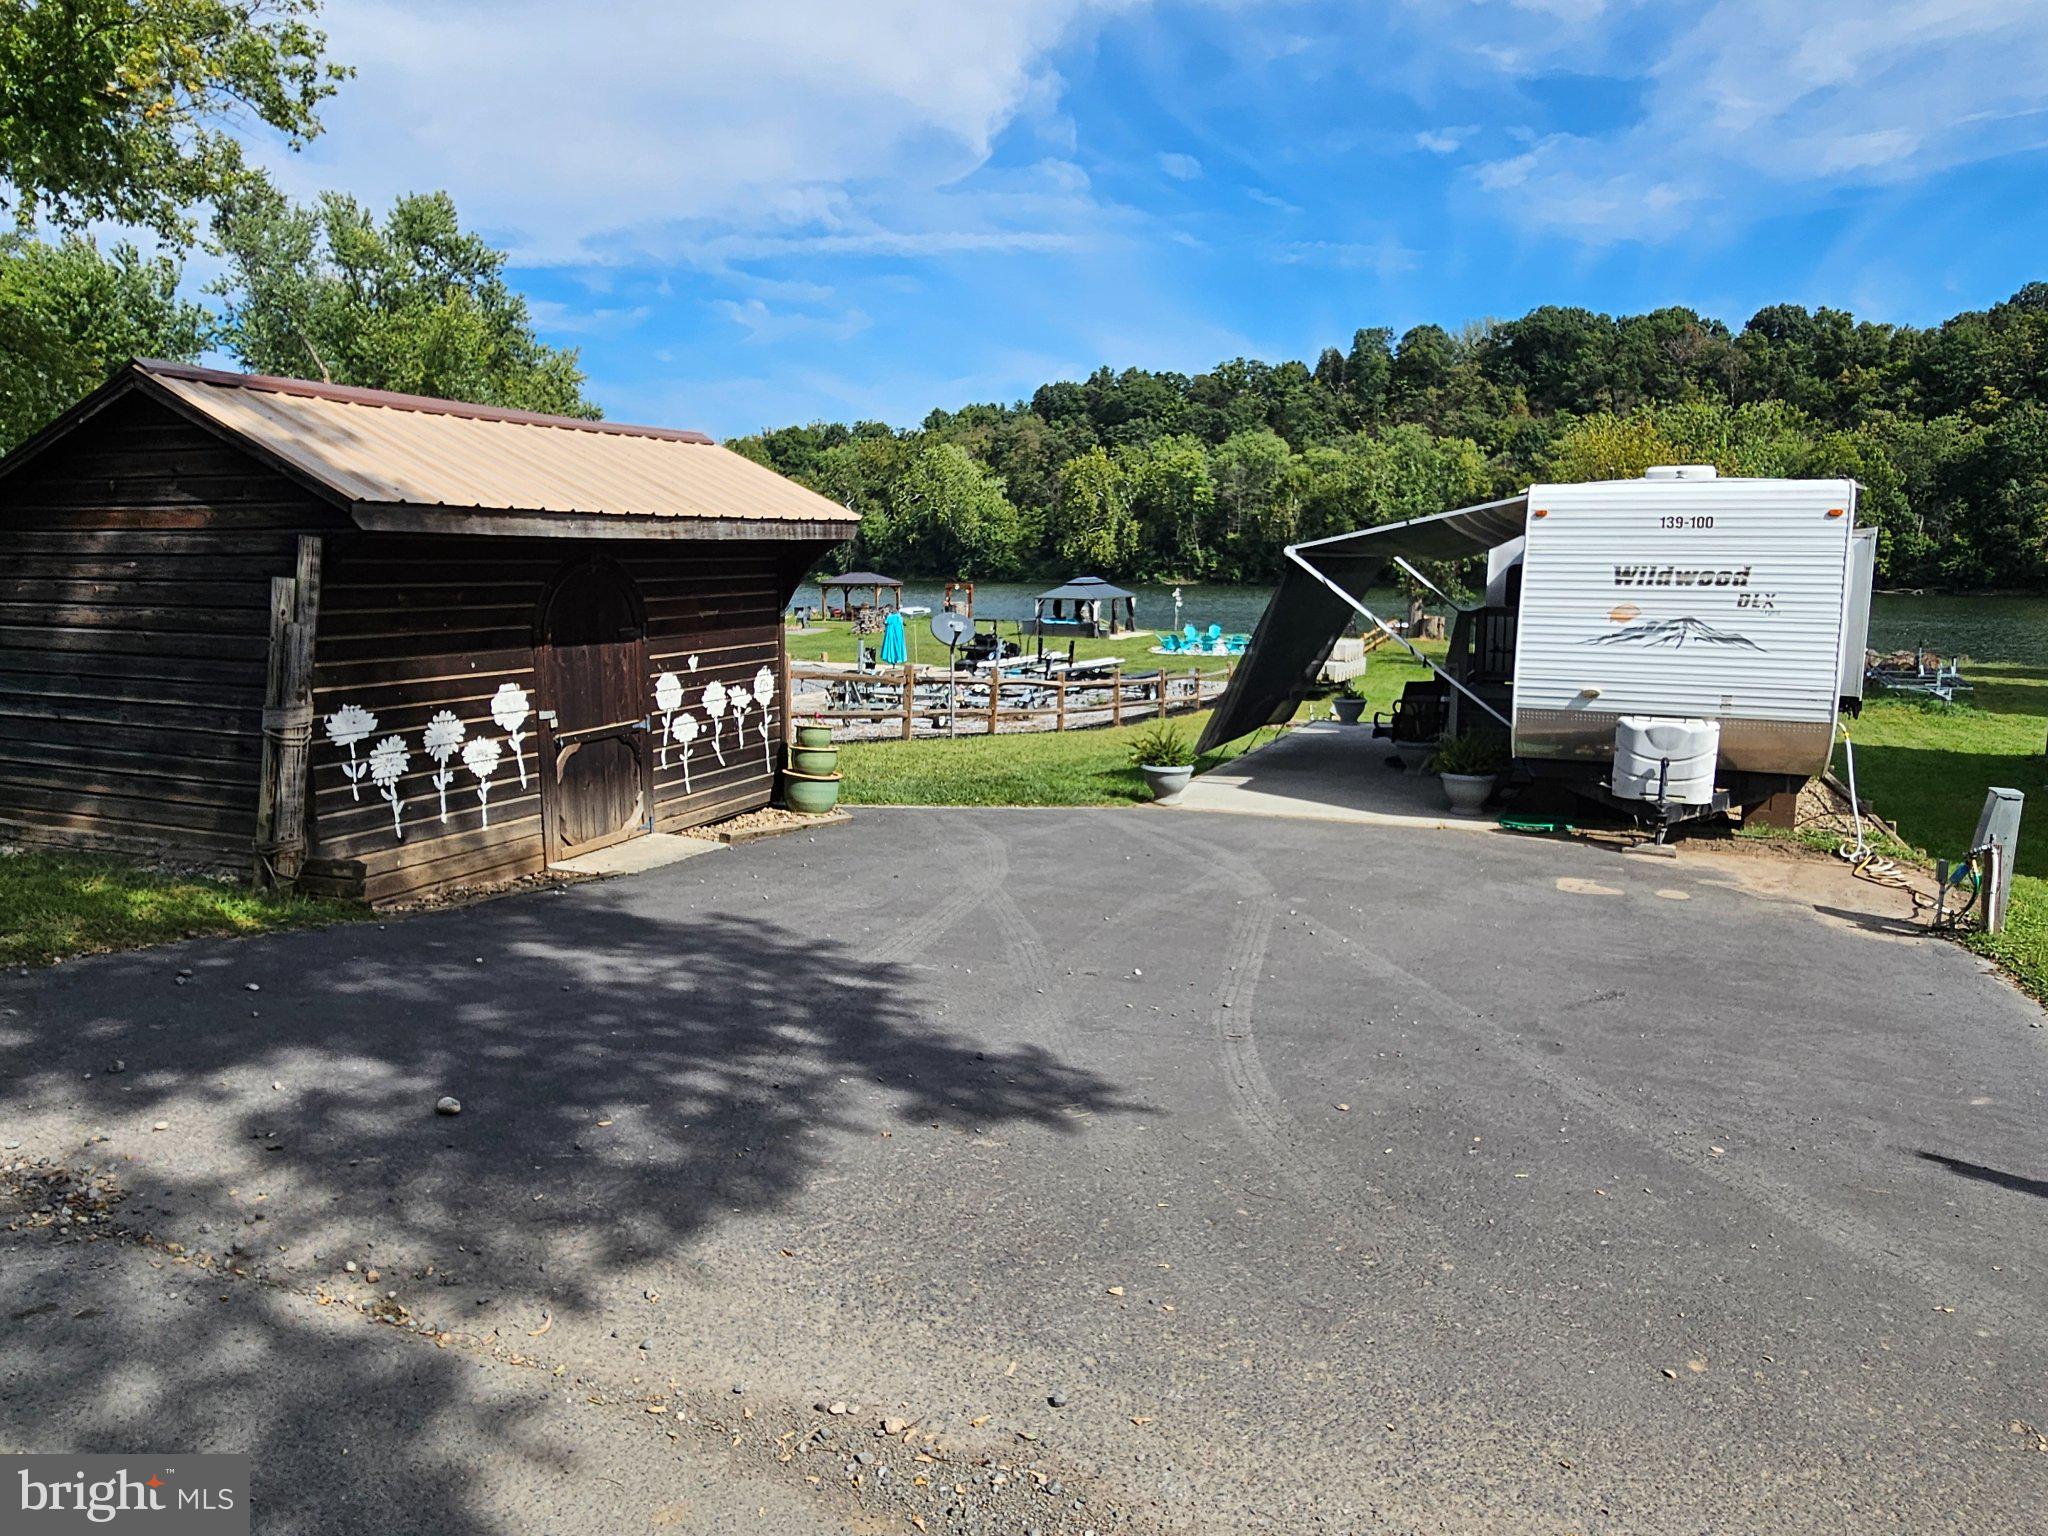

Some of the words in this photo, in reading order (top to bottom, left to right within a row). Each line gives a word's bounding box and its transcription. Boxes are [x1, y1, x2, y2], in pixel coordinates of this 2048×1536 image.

[1659, 516, 1714, 529] 139-100
[1613, 565, 1752, 587] Wildwood
[1736, 593, 1776, 608] DLX
